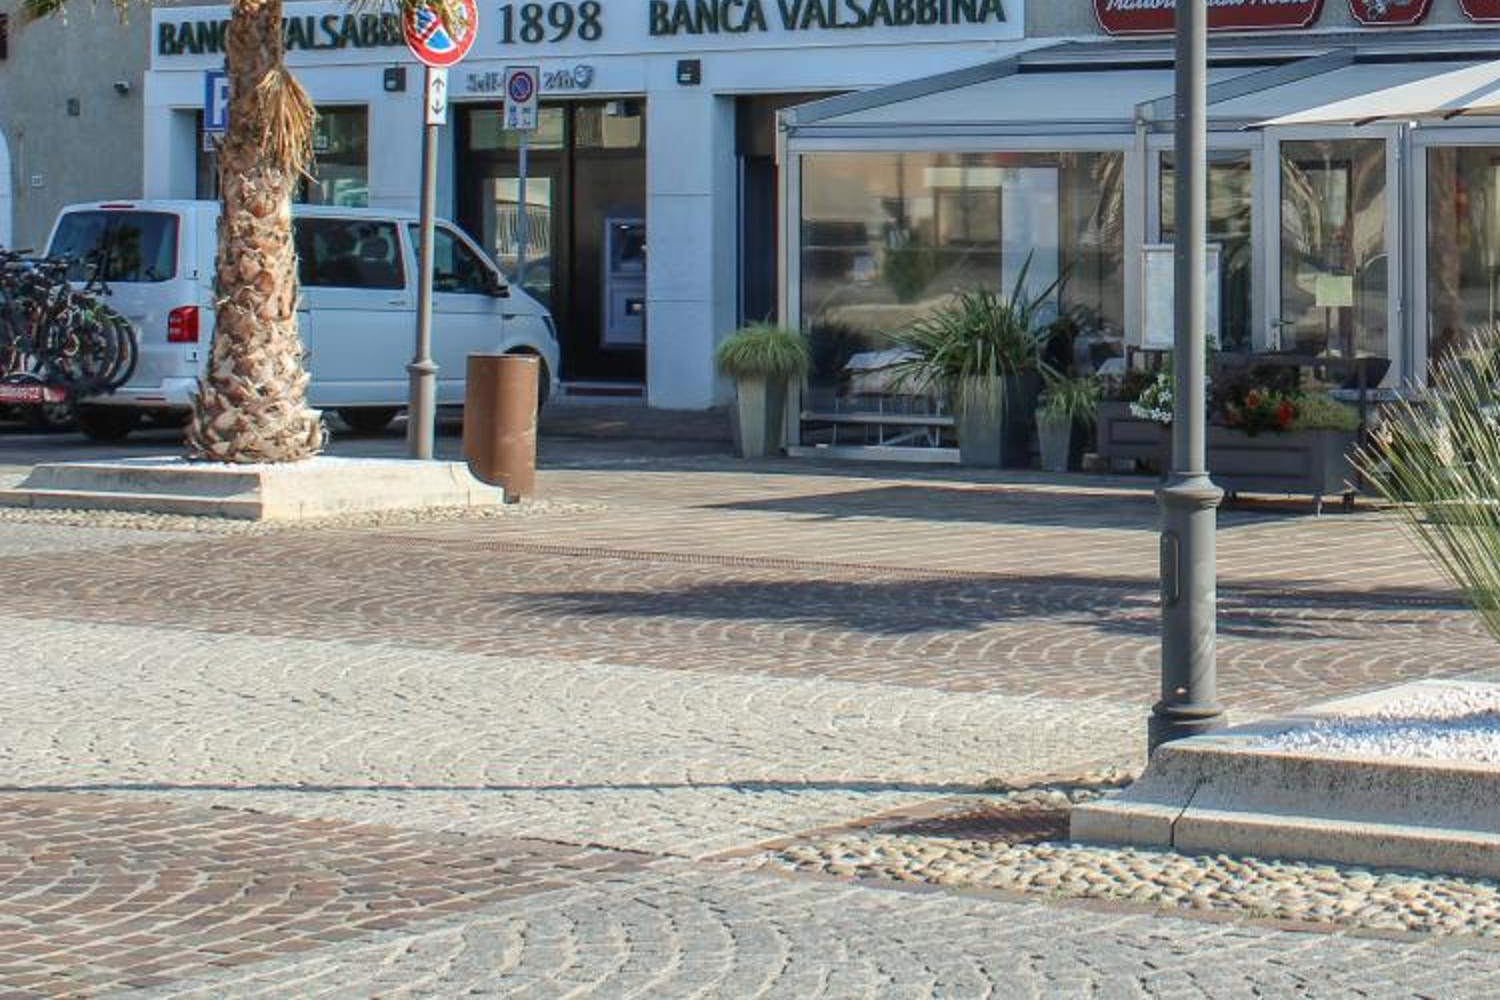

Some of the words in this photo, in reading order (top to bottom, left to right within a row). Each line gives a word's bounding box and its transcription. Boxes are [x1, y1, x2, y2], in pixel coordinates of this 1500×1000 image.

[159, 20, 227, 55] BAN
[282, 13, 407, 50] ALSABB
[499, 0, 602, 44] 1898
